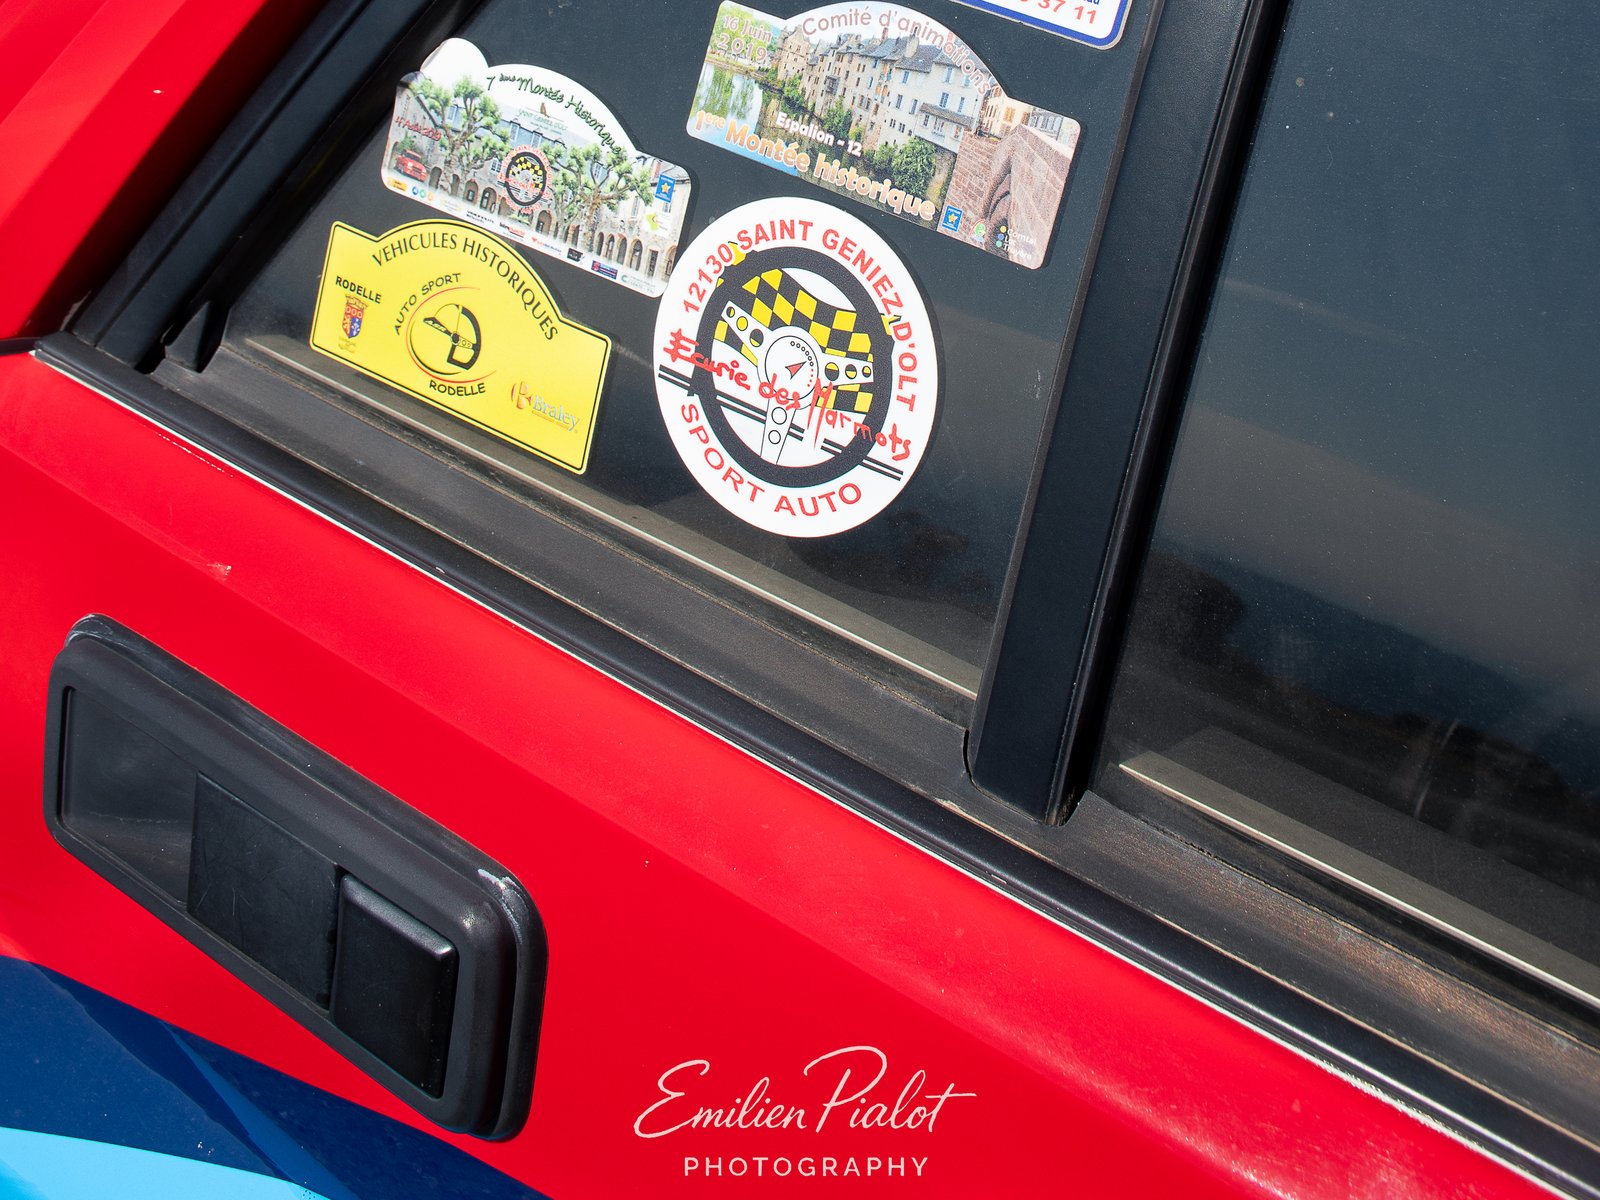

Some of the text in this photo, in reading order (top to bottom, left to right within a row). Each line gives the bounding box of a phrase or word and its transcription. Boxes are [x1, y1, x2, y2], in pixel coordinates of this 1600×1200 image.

[723, 15, 773, 44] 16 Juin
[1074, 5, 1097, 24] 11
[717, 32, 768, 64] 2019
[802, 6, 991, 97] Comité d'animations
[486, 75, 495, 91] 7
[516, 76, 564, 103] Montée
[565, 95, 622, 154] Historique
[776, 111, 835, 147] Espalion
[848, 140, 863, 158] 12
[725, 119, 811, 173] Montée
[814, 152, 937, 221] historique
[335, 275, 382, 305] RODELLE
[372, 232, 559, 341] VEHICULES HISTORIQUES
[394, 272, 462, 335] AUTO SPORT
[683, 219, 918, 412] 12130 SAINT GENIEZ D'OLT
[428, 379, 486, 397] RODELLE
[533, 395, 580, 432] Braley
[758, 373, 801, 410] des
[806, 377, 911, 461] Marmots
[680, 403, 862, 517] SPORT AUTO
